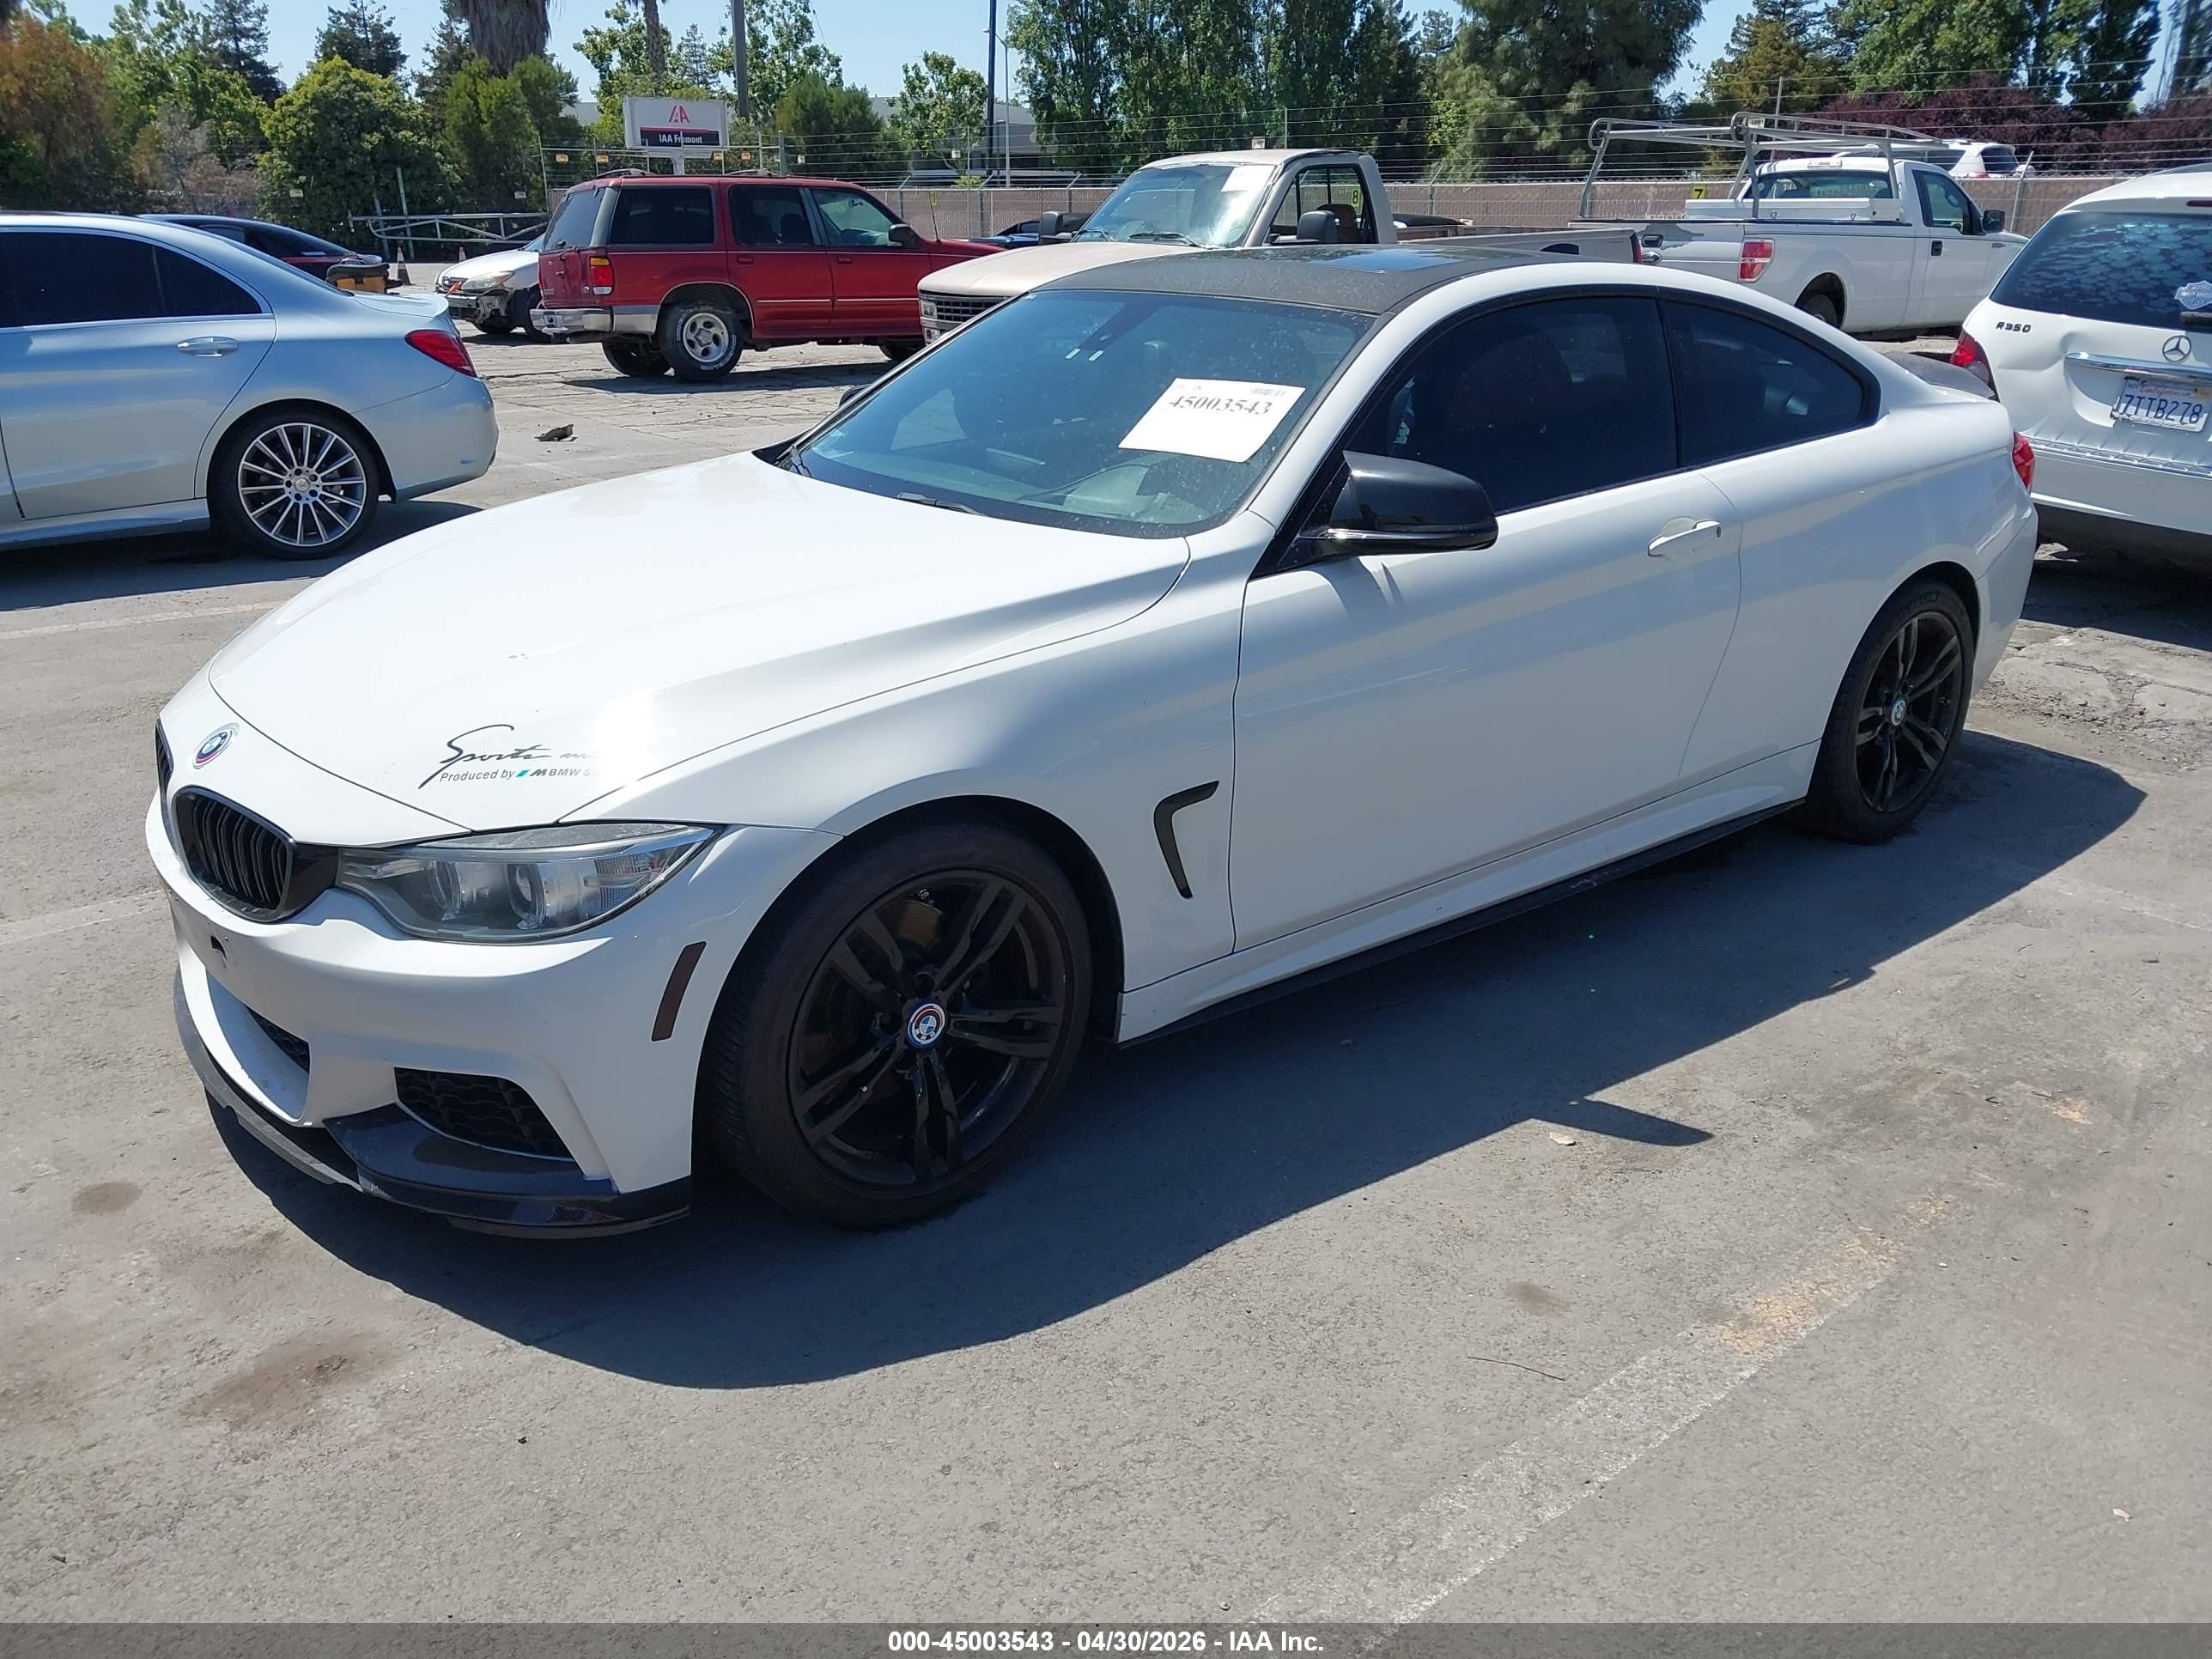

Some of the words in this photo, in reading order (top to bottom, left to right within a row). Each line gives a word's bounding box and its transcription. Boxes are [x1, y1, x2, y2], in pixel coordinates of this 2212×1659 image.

[659, 133, 673, 143] IAA
[1352, 189, 1359, 204] 8
[1694, 188, 1705, 199] 7
[1996, 321, 2032, 333] R350
[1169, 395, 1273, 415] 45003543
[2123, 394, 2203, 425] 7TTB278
[439, 769, 499, 782] Produced
[501, 769, 515, 781] by
[549, 769, 581, 777] BMW
